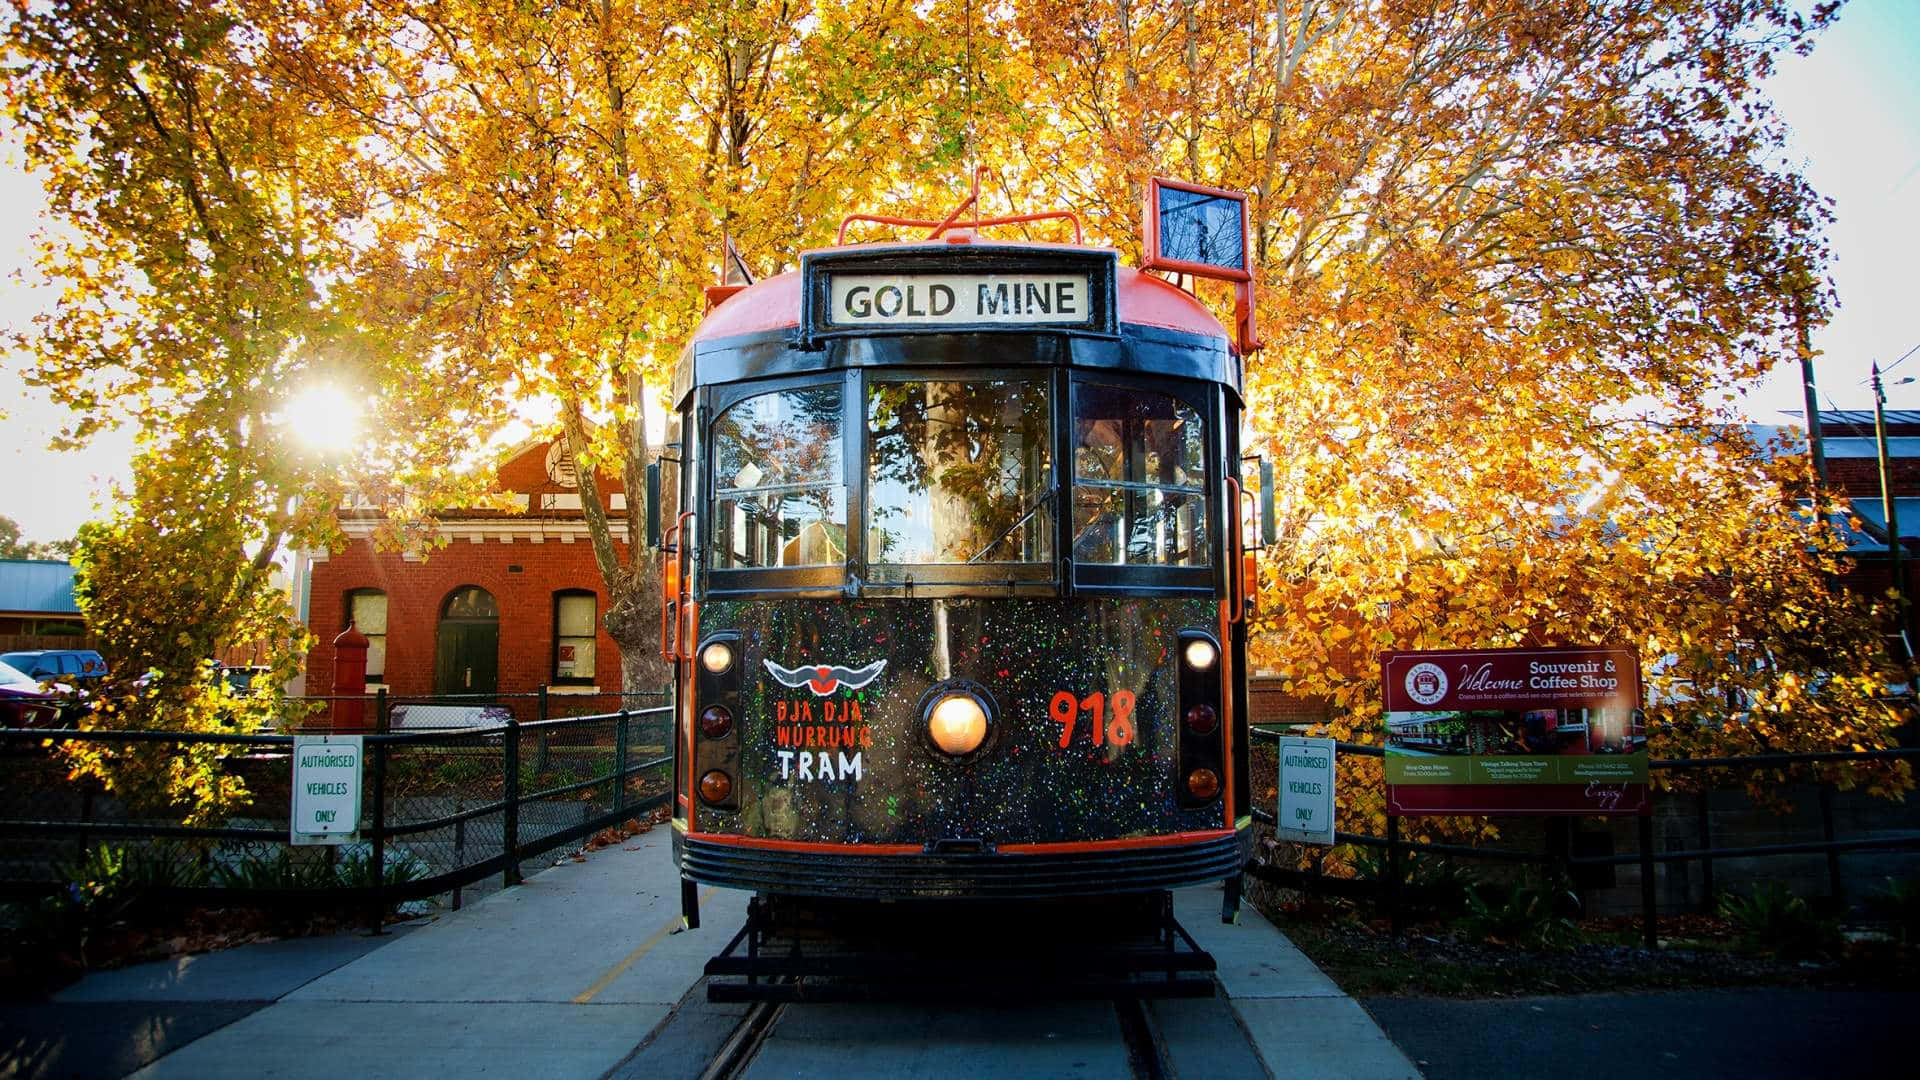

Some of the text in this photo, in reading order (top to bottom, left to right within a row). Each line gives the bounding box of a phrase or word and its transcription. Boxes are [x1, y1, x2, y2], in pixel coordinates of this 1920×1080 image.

[845, 282, 1076, 318] GOLD MINE
[1530, 659, 1616, 674] Souvenir &
[1457, 662, 1524, 692] Welcome
[1530, 675, 1618, 690] Coffee Shop
[776, 700, 862, 722] DJA DJA
[1049, 690, 1136, 749] 918
[776, 725, 874, 748] WURRUNG
[300, 755, 355, 768] AUTHORISED
[777, 751, 862, 782] TRAM
[1284, 755, 1328, 769] AUTHORISED
[306, 782, 348, 795] VEHICLES
[1288, 781, 1322, 795] VEHICLES
[315, 810, 337, 823] ONLY
[1295, 807, 1313, 820] ONLY
